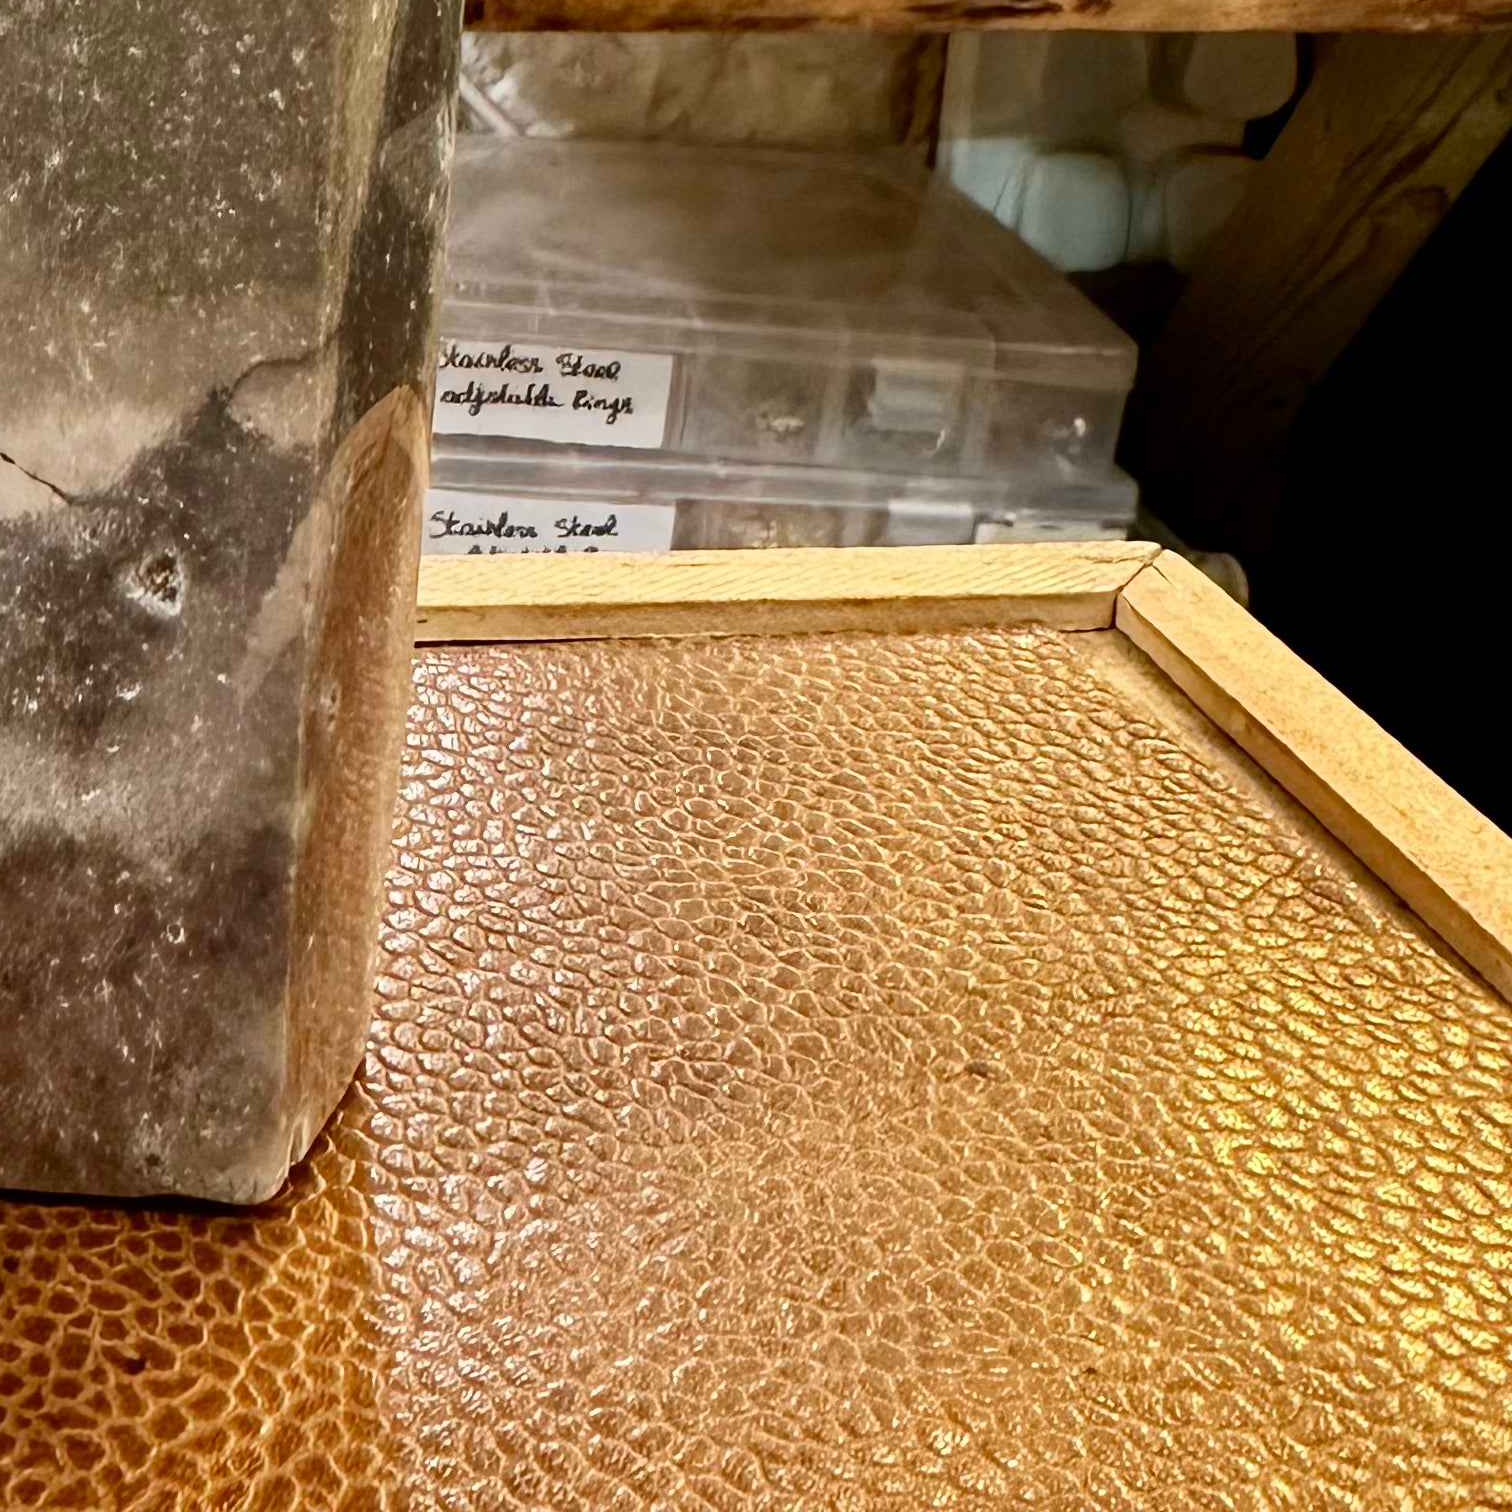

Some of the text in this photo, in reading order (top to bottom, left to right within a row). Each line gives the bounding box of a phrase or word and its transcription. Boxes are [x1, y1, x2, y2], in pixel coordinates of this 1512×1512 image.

[439, 344, 622, 380] Stainless Steel
[440, 380, 634, 425] adjustable Rings
[429, 511, 620, 539] Stainless Steel
